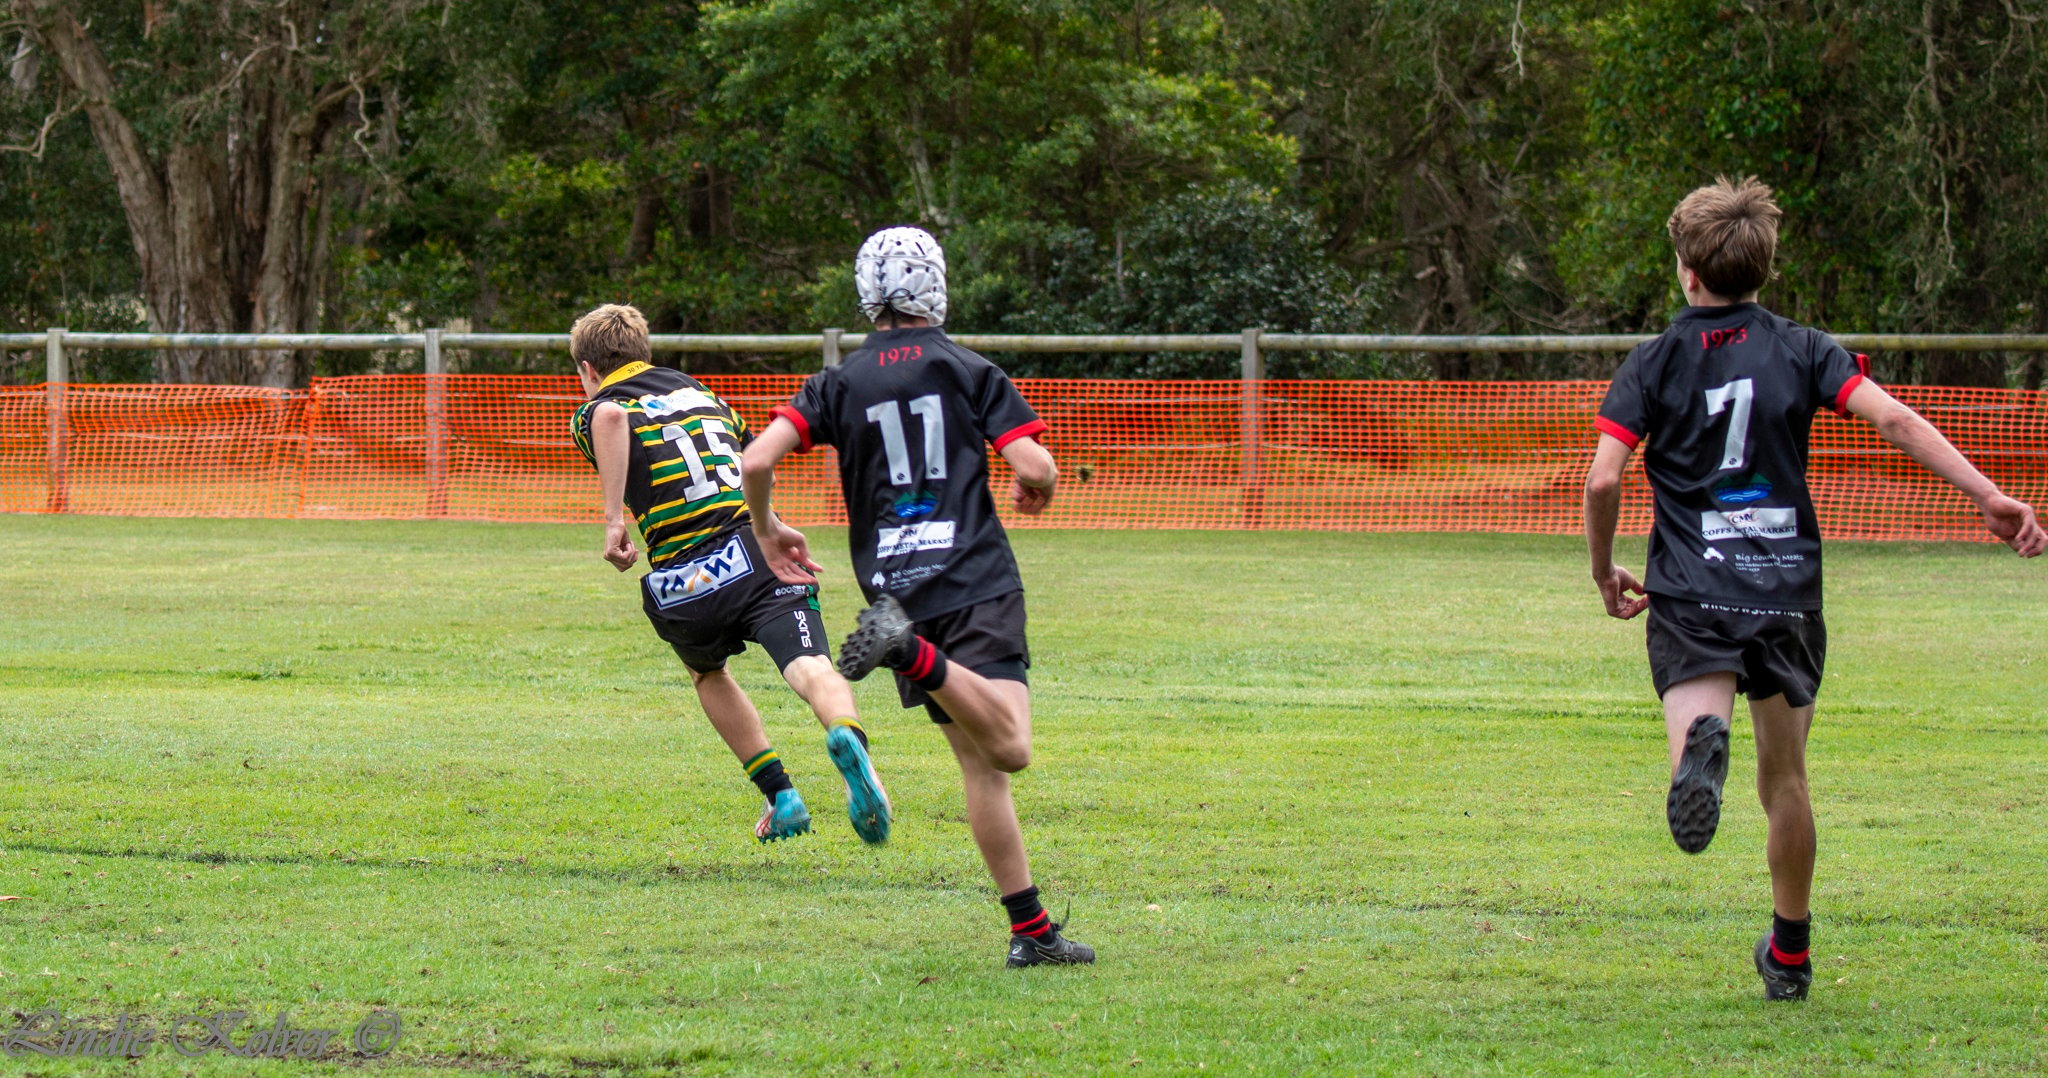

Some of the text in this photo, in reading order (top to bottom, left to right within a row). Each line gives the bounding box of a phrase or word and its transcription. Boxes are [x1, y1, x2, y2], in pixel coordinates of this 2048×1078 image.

[878, 345, 922, 366] 1973
[1701, 328, 1748, 350] 1973
[866, 394, 947, 486] 11
[1705, 378, 1754, 471] 7
[661, 418, 743, 503] 15
[1702, 527, 1732, 537] COFFS
[1759, 525, 1797, 534] MARKET
[794, 610, 813, 648] SKINS
